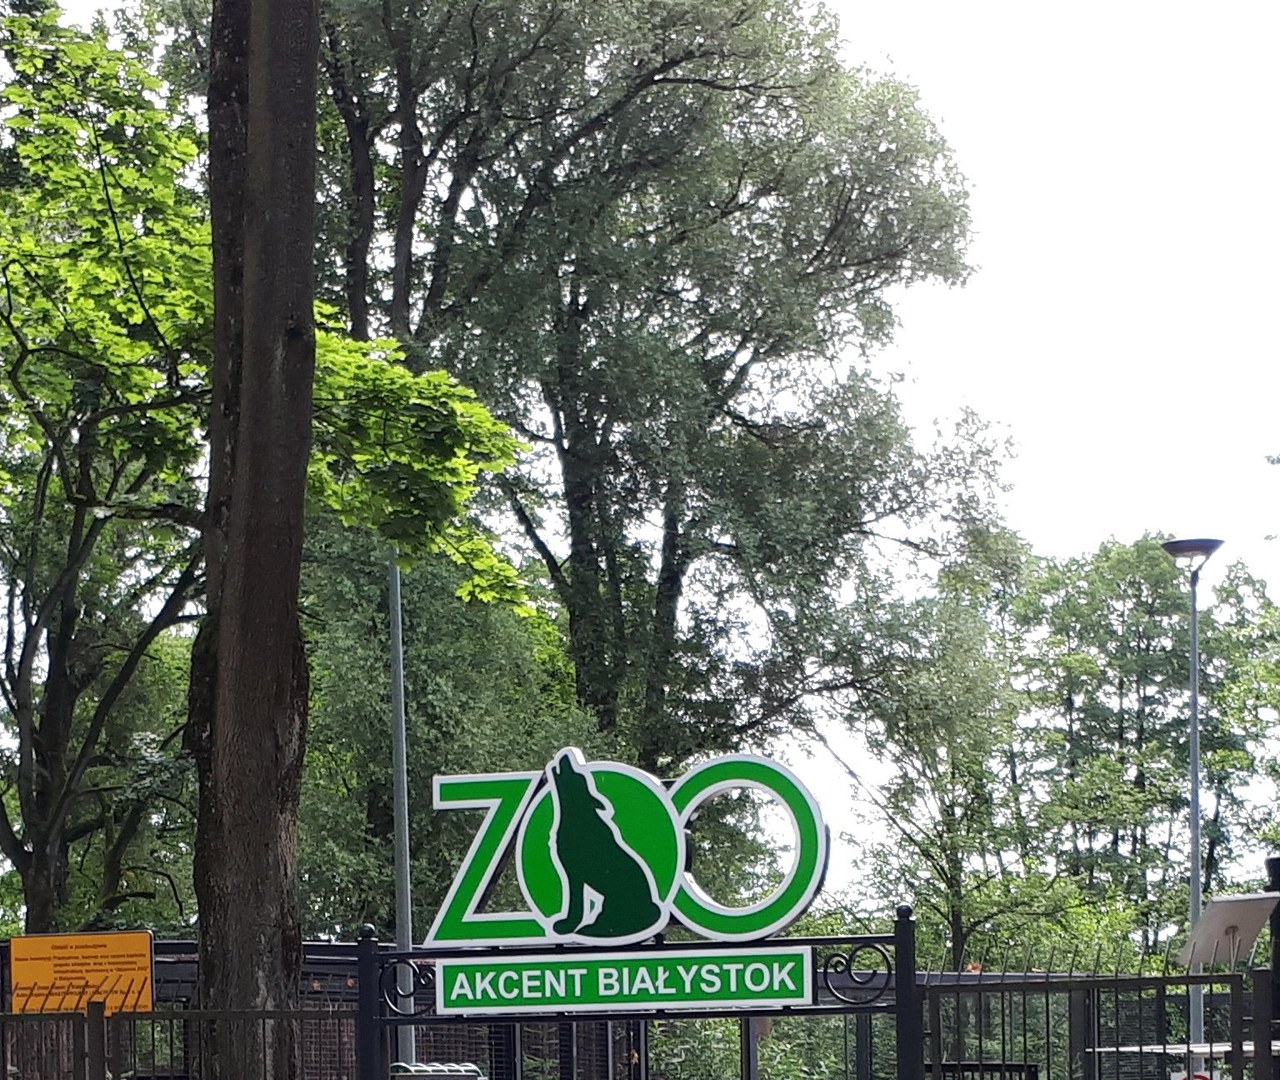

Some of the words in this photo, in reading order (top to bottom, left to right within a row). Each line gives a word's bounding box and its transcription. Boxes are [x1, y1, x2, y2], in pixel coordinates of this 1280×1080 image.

[424, 750, 828, 948] ZOO
[451, 968, 587, 1001] AKCENT
[598, 961, 797, 997] BIAŁYSTOK
